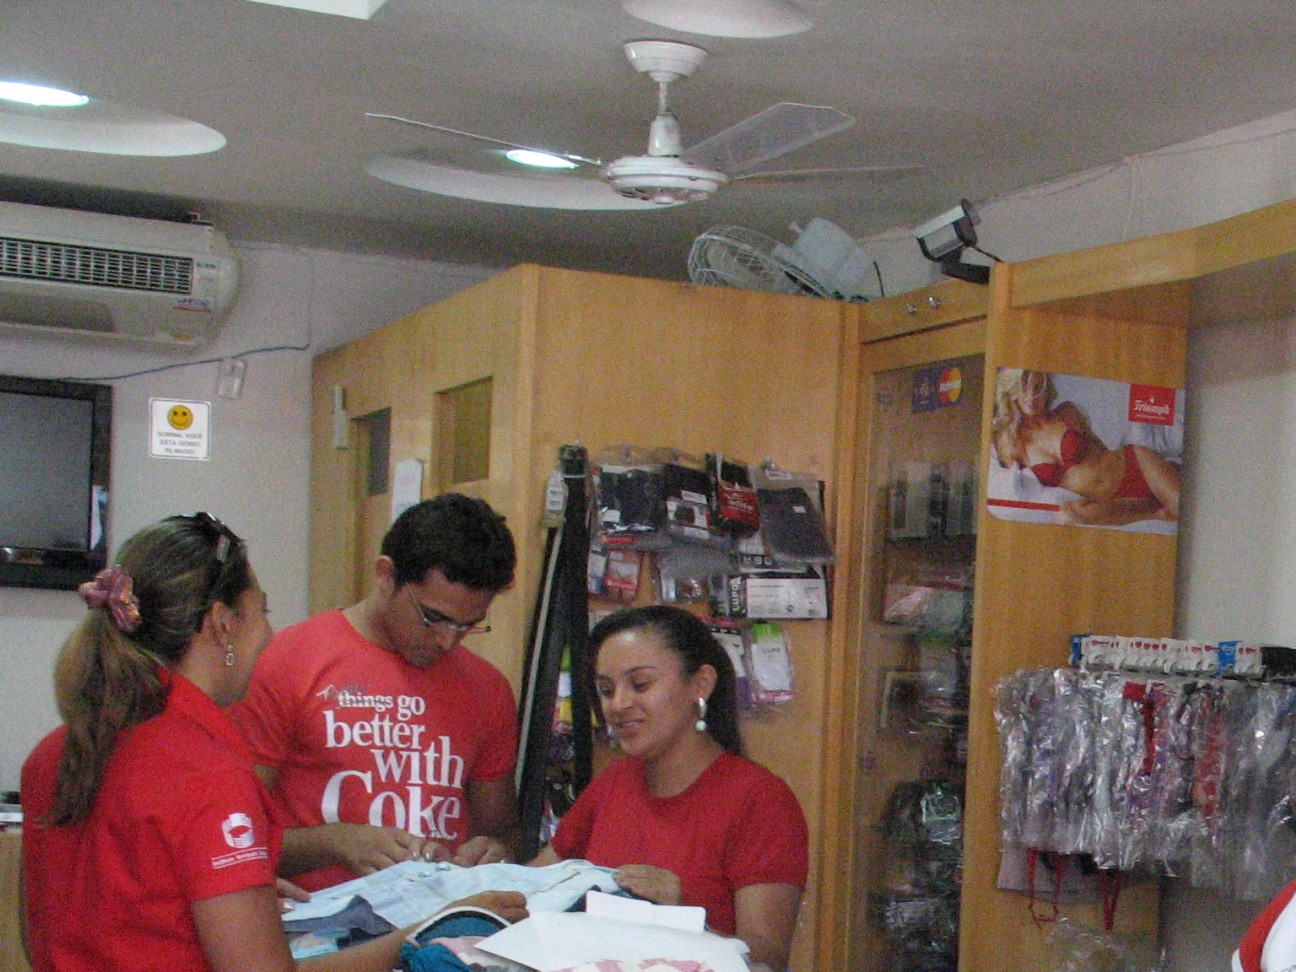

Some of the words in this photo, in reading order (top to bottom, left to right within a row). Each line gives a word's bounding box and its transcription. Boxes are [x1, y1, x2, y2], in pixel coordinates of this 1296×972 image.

[323, 710, 426, 749] better
[397, 695, 426, 721] go
[370, 736, 465, 789] with
[321, 770, 460, 841] Coke
